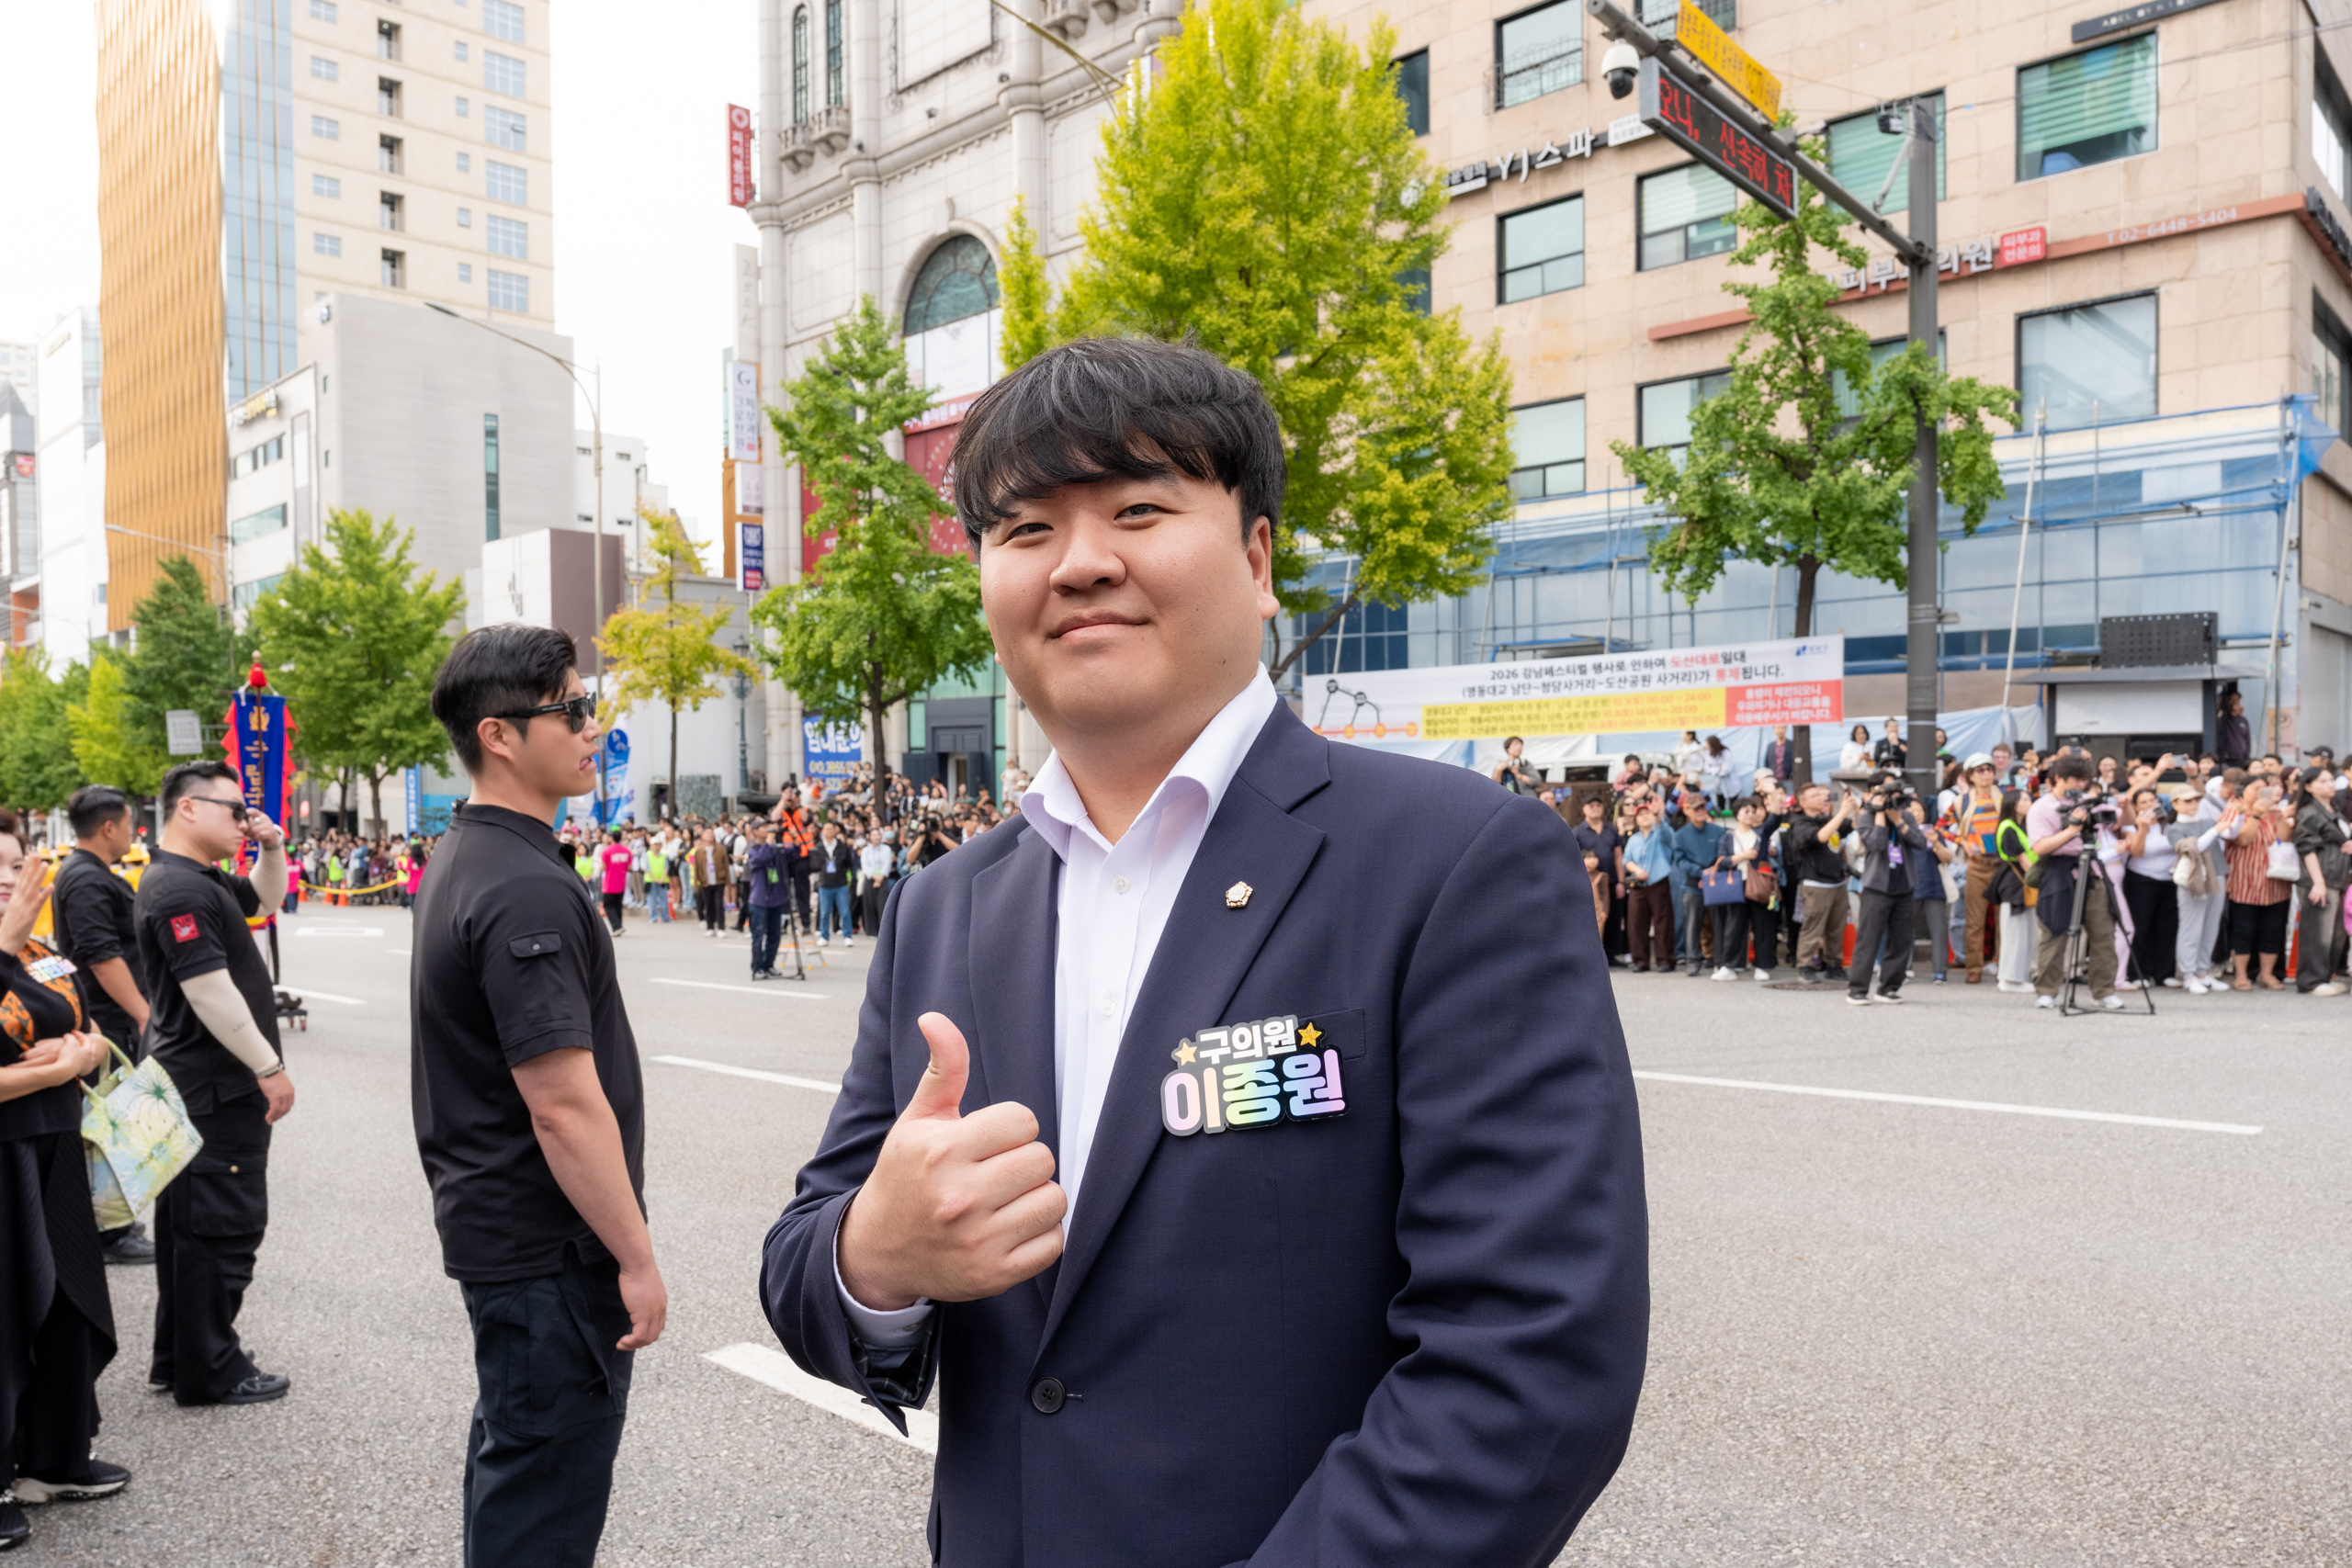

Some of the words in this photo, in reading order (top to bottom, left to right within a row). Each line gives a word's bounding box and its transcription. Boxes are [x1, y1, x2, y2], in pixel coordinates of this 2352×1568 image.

[1495, 126, 1596, 183] YJ스파
[1720, 122, 1769, 191] 신속히
[1199, 1018, 1297, 1065] 구의원
[1163, 1048, 1346, 1131] 이종원
